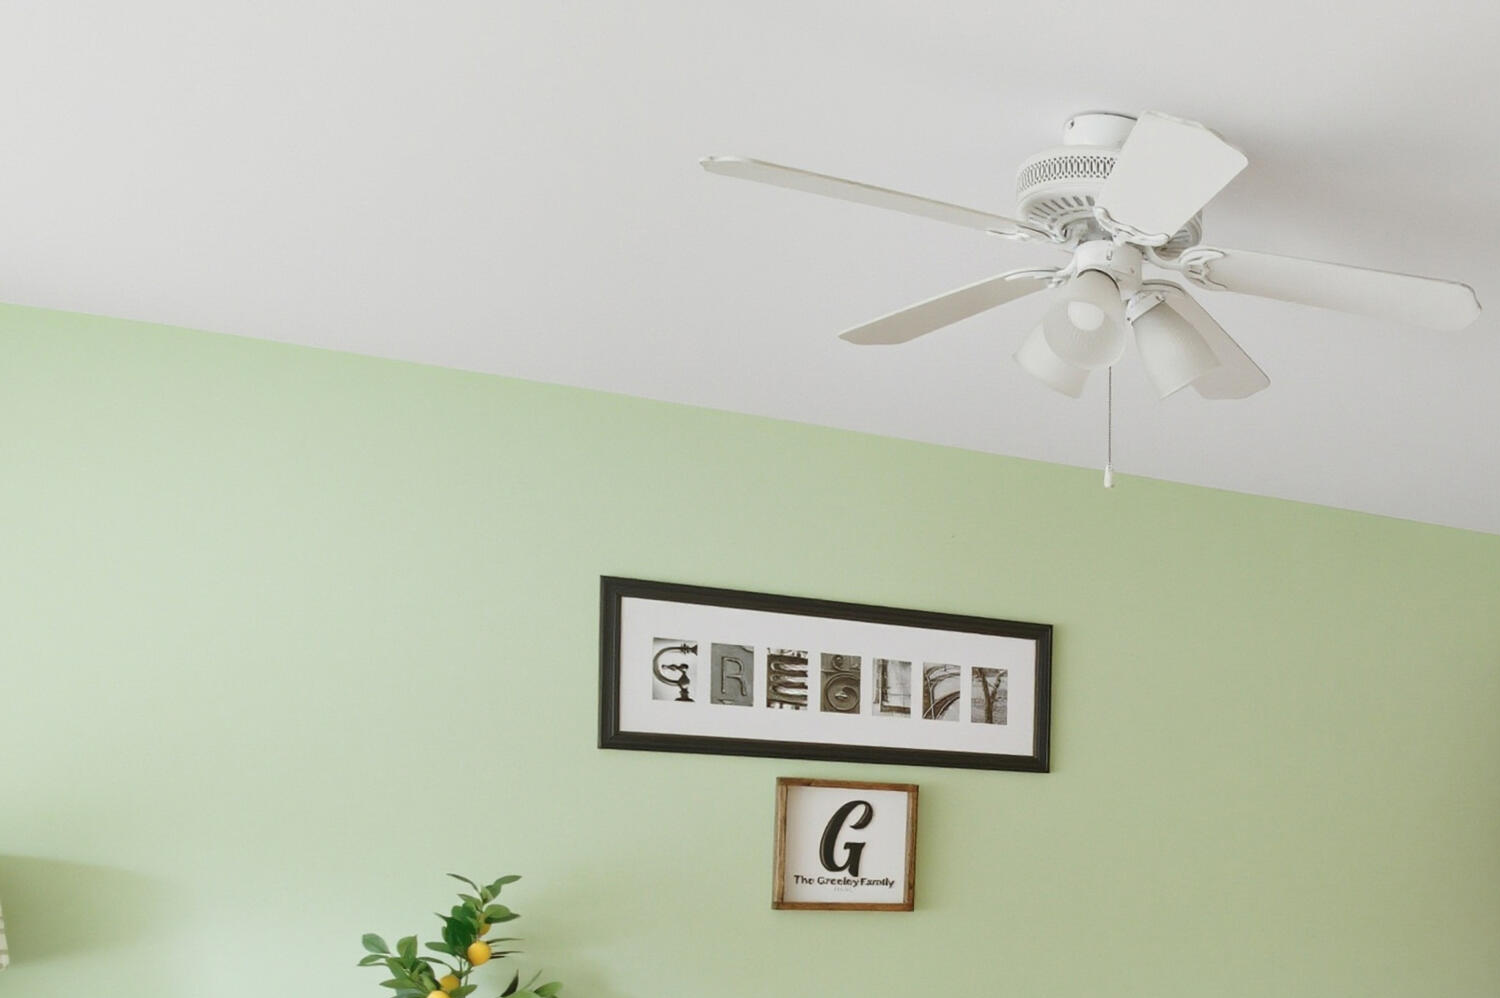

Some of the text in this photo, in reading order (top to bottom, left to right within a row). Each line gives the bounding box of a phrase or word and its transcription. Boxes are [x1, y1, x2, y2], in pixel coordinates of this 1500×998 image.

[819, 799, 874, 877] G
[793, 874, 895, 888] The Greeley Family
